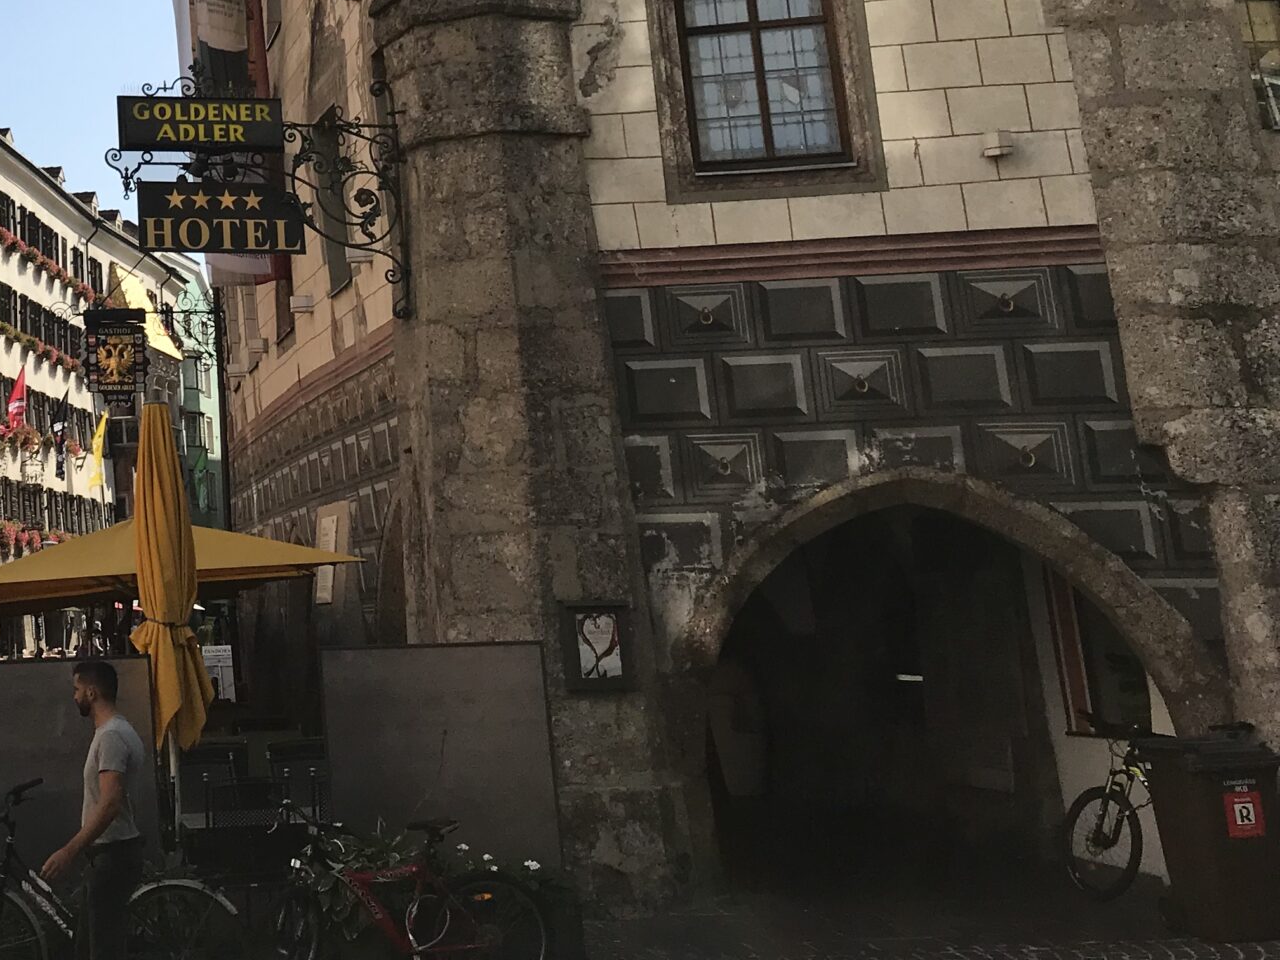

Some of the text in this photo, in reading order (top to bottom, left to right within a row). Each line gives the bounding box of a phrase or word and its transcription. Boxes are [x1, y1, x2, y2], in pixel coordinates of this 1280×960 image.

[132, 102, 272, 122] GOLDENER
[156, 123, 246, 142] ADLER
[143, 217, 302, 250] HOTEL
[98, 327, 132, 335] GASTHOF
[1239, 805, 1253, 823] R
